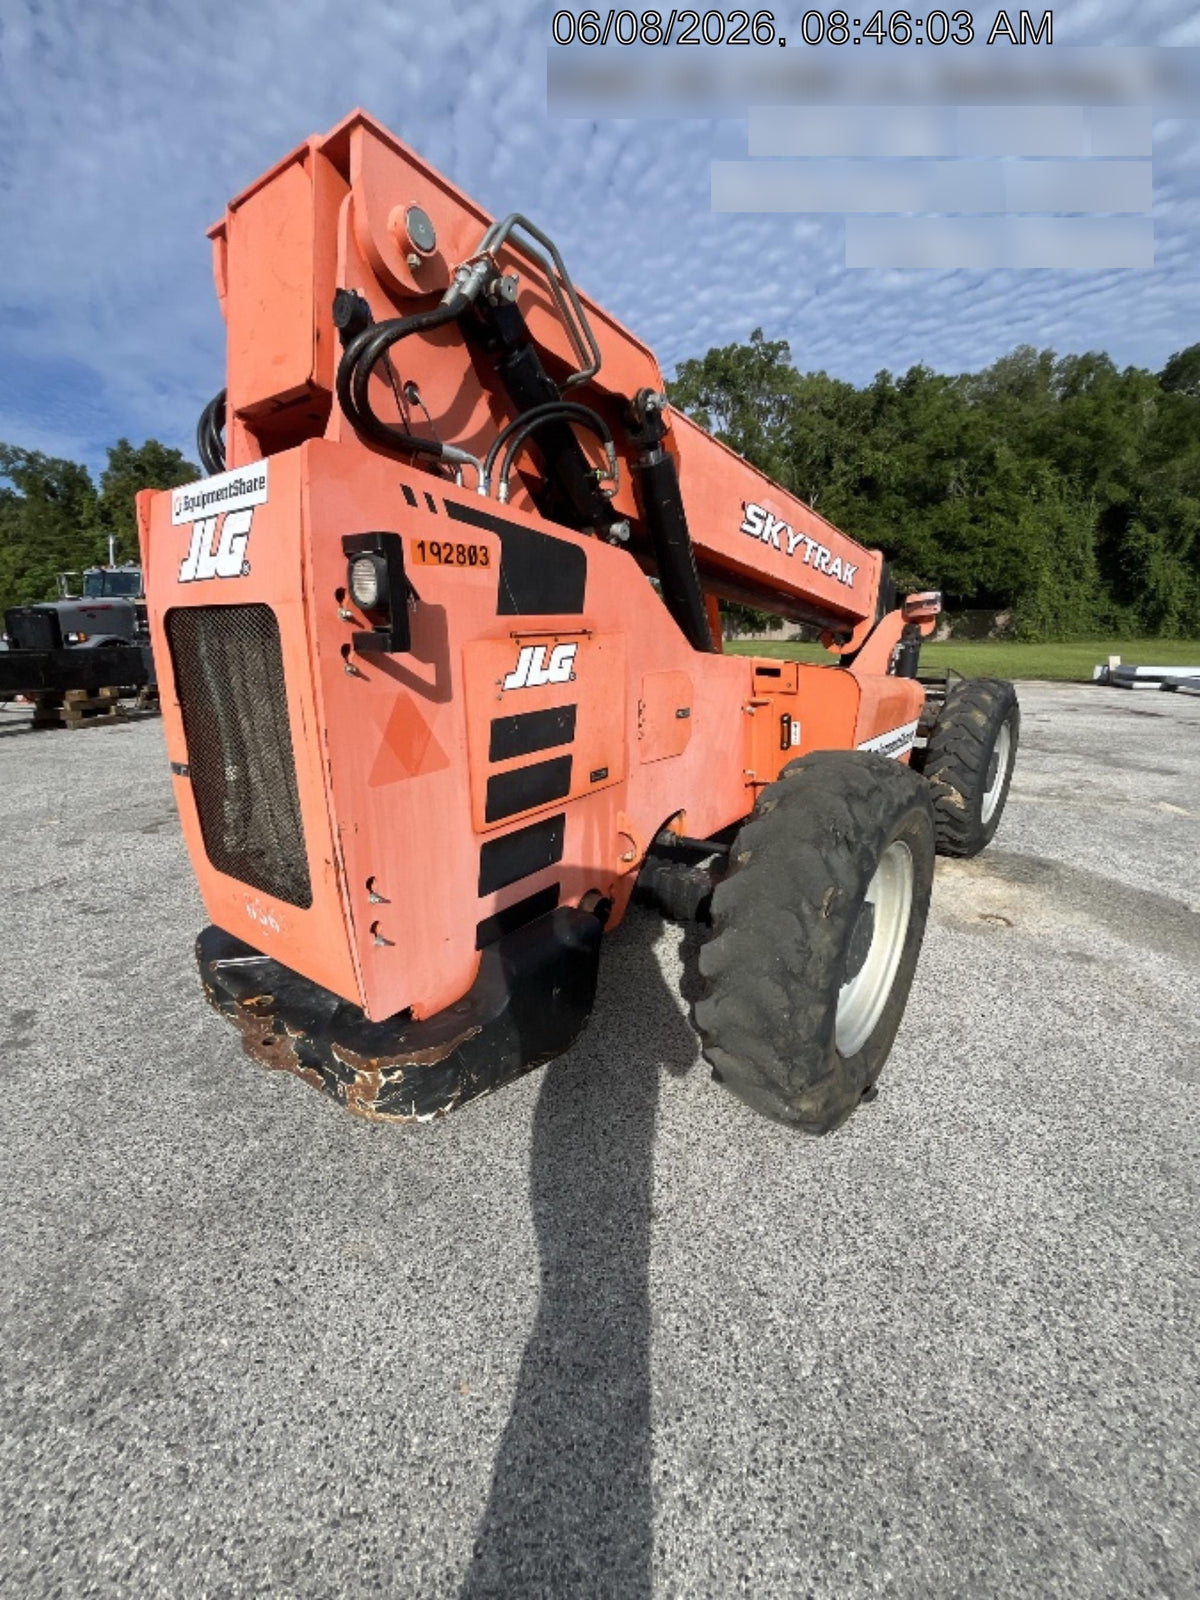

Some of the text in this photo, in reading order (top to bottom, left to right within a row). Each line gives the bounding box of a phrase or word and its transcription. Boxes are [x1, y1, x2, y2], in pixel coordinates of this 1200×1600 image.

[183, 475, 266, 512] EquipmentShare
[178, 506, 254, 583] JLG
[417, 540, 490, 566] 192803
[739, 502, 859, 588] SKYTRAK
[501, 642, 578, 691] JLG
